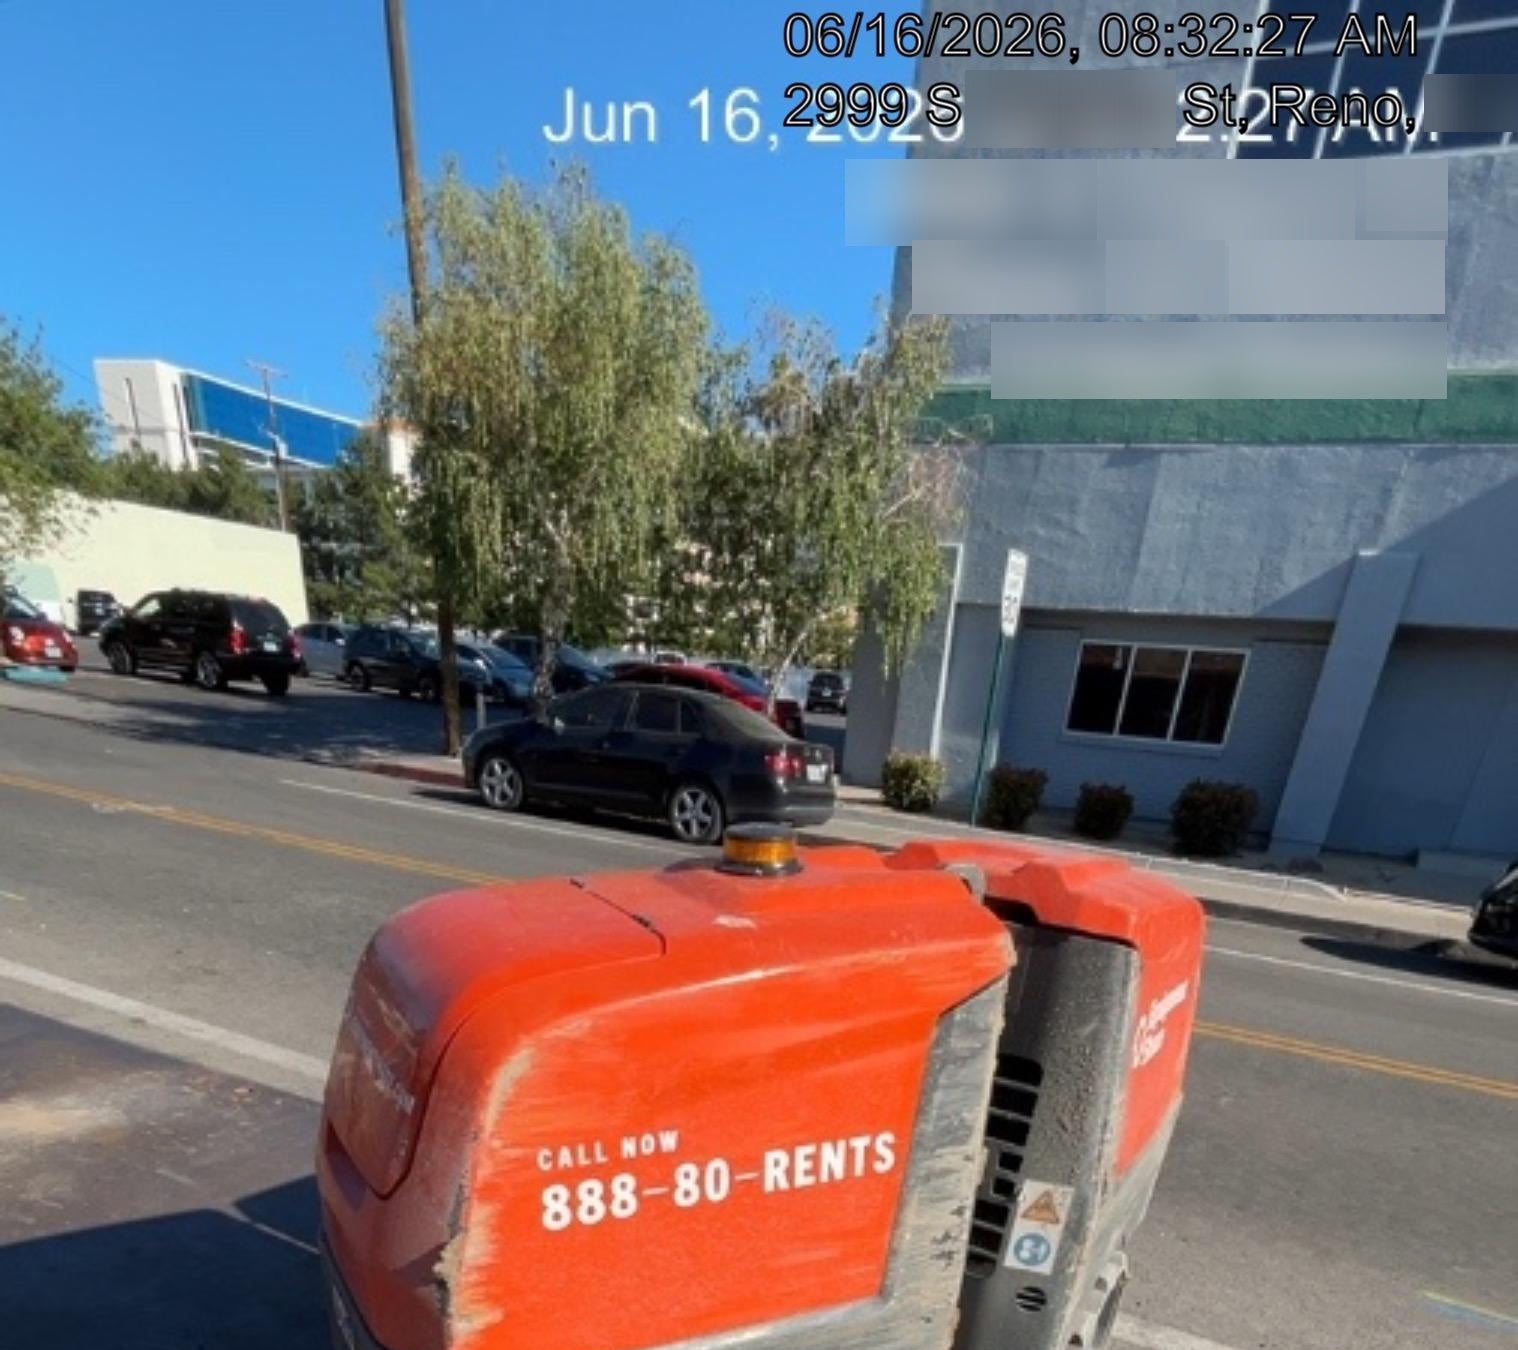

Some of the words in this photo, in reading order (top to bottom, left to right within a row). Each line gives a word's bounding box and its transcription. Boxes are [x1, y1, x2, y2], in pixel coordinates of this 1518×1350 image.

[536, 1140, 609, 1171] CALL
[620, 1129, 680, 1159] NOW
[541, 1131, 896, 1231] 888-80-RENTS
